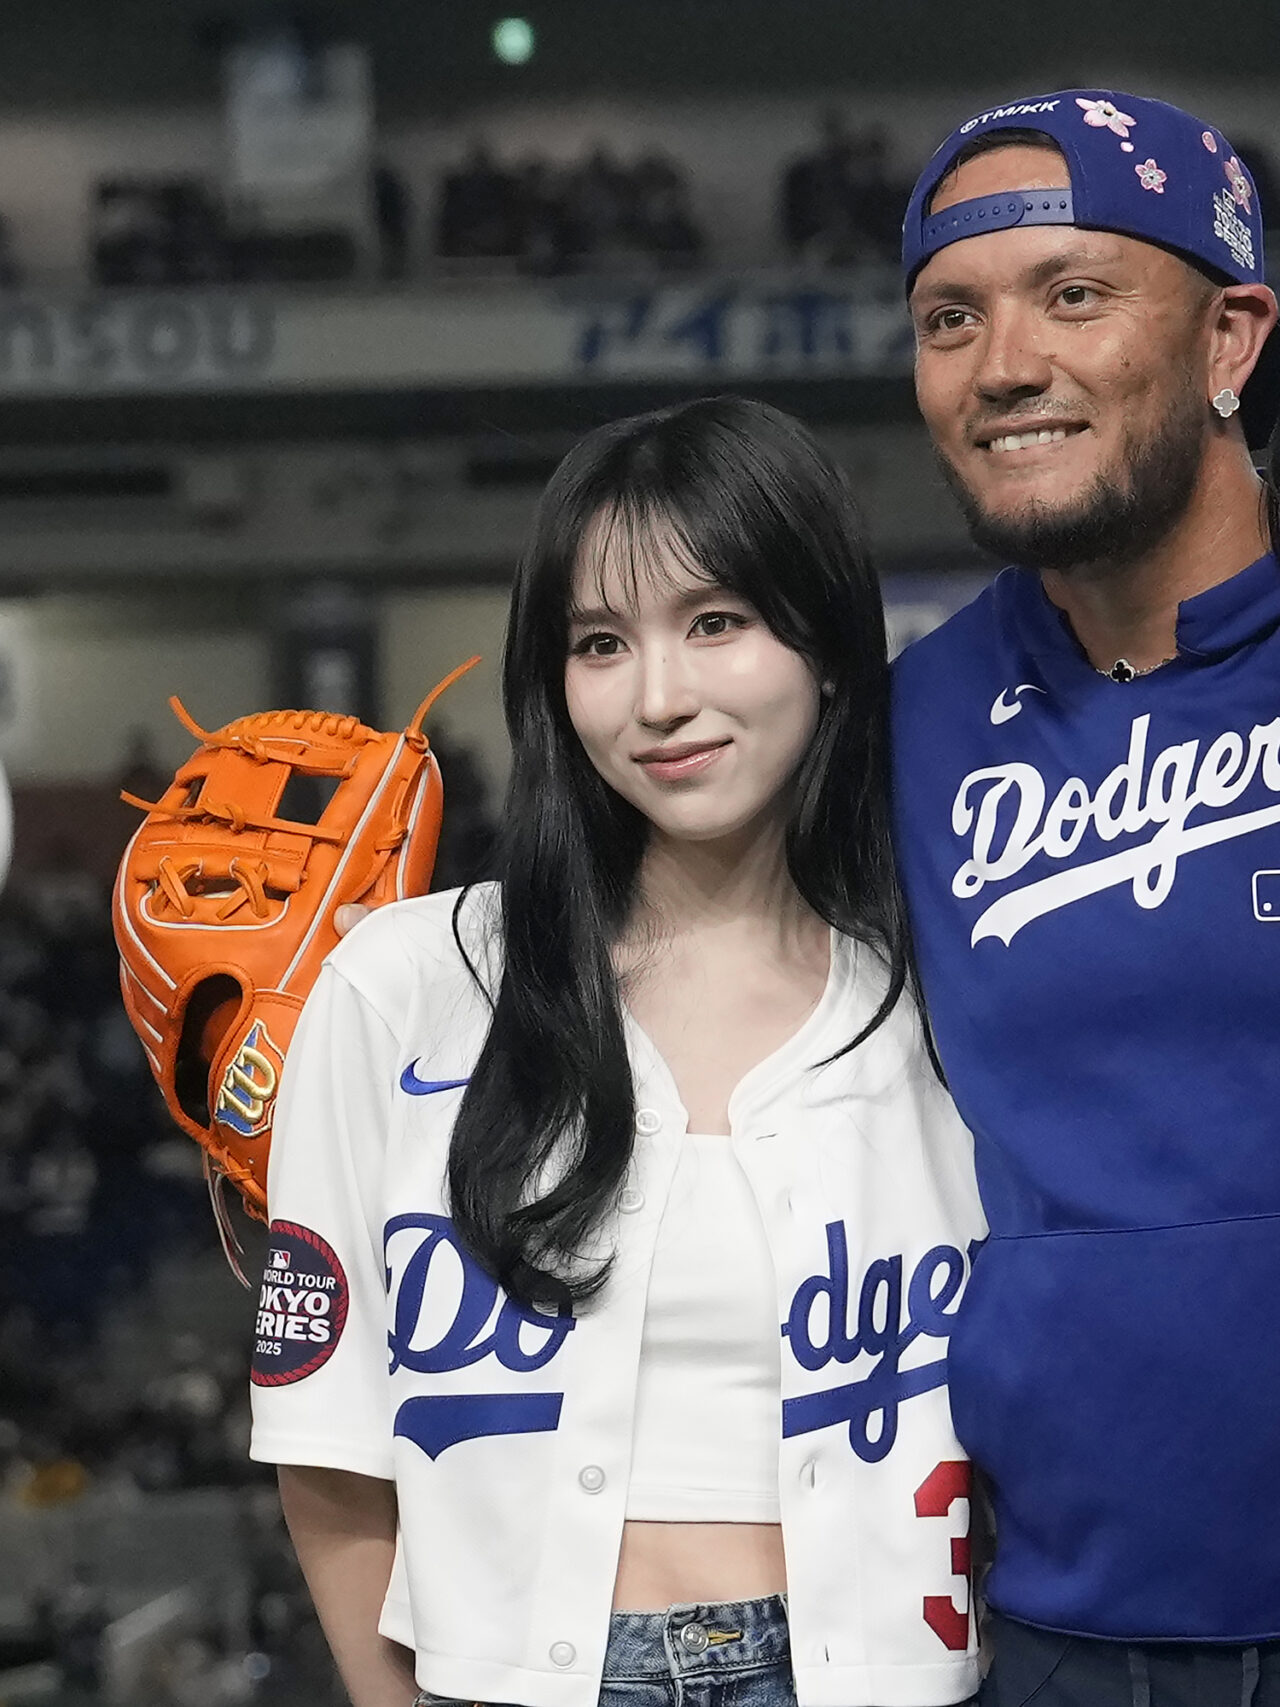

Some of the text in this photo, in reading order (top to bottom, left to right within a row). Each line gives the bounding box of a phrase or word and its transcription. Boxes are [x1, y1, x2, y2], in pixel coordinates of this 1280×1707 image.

[297, 1273, 336, 1290] TOUR
[259, 1284, 331, 1316] OKYO
[255, 1310, 331, 1344] ERIES
[256, 1339, 282, 1356] 2025
[914, 1460, 973, 1652] 3
